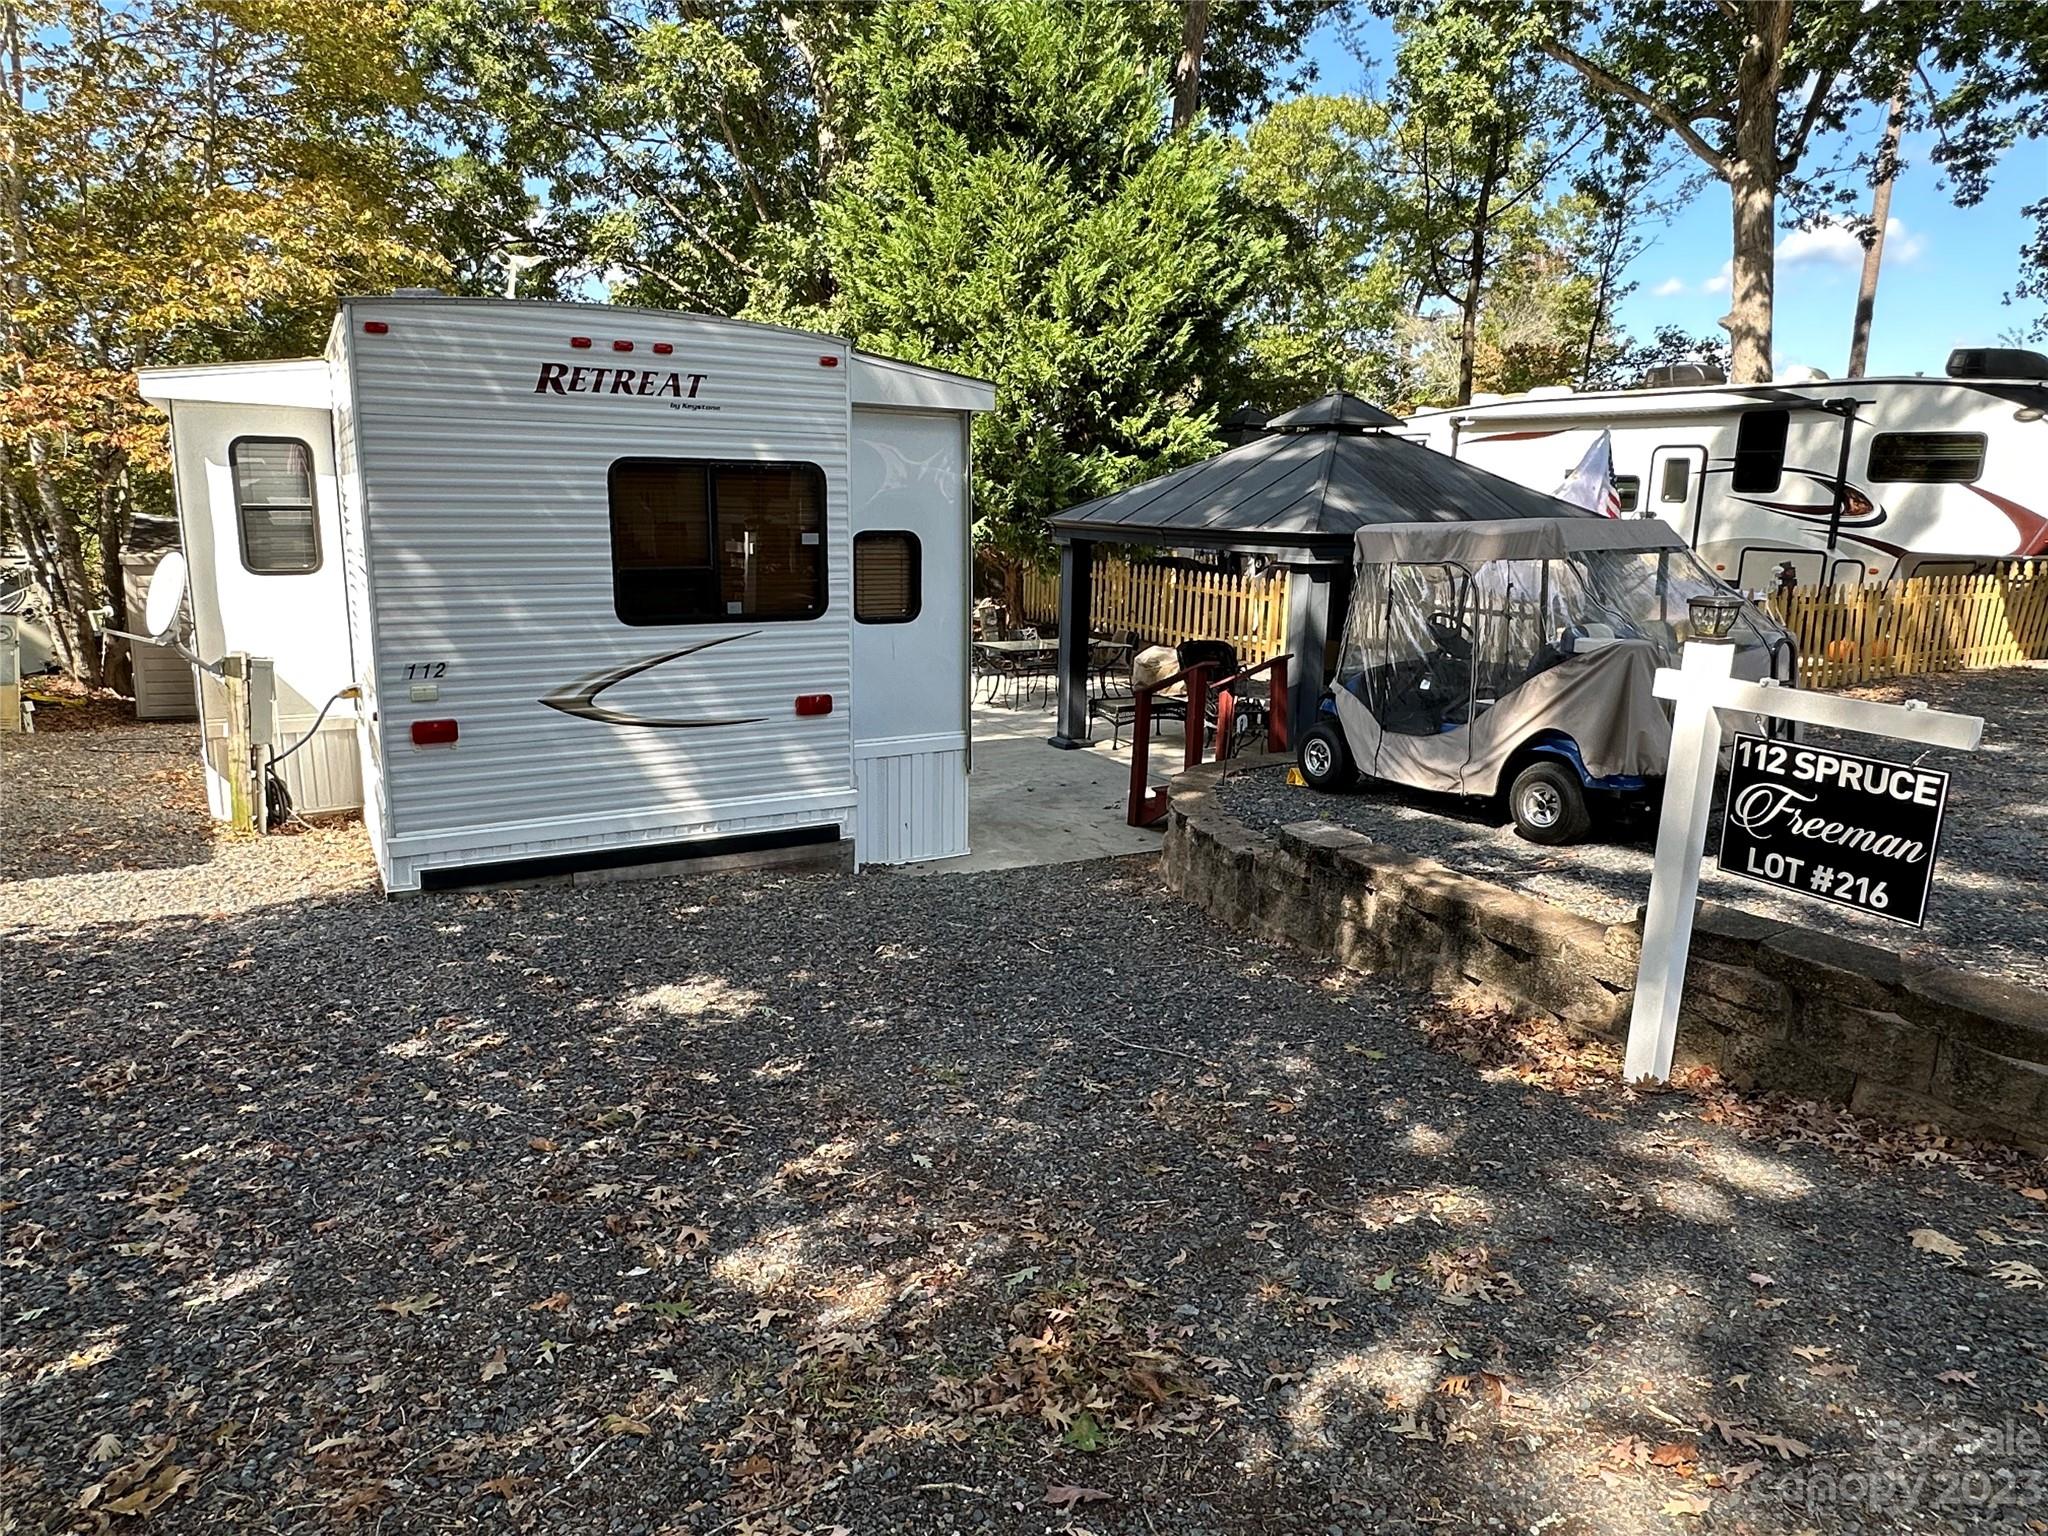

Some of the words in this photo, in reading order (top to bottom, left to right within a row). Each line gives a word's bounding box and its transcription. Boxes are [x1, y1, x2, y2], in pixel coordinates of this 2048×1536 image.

[533, 362, 708, 399] RETREAT
[669, 402, 681, 411] by
[408, 662, 446, 680] 112
[1739, 741, 1788, 775] 112
[1792, 752, 1941, 807] SPRUCE
[1730, 782, 1927, 863] Freeman
[1747, 847, 1805, 884] LOT
[1810, 864, 1889, 909] #216
